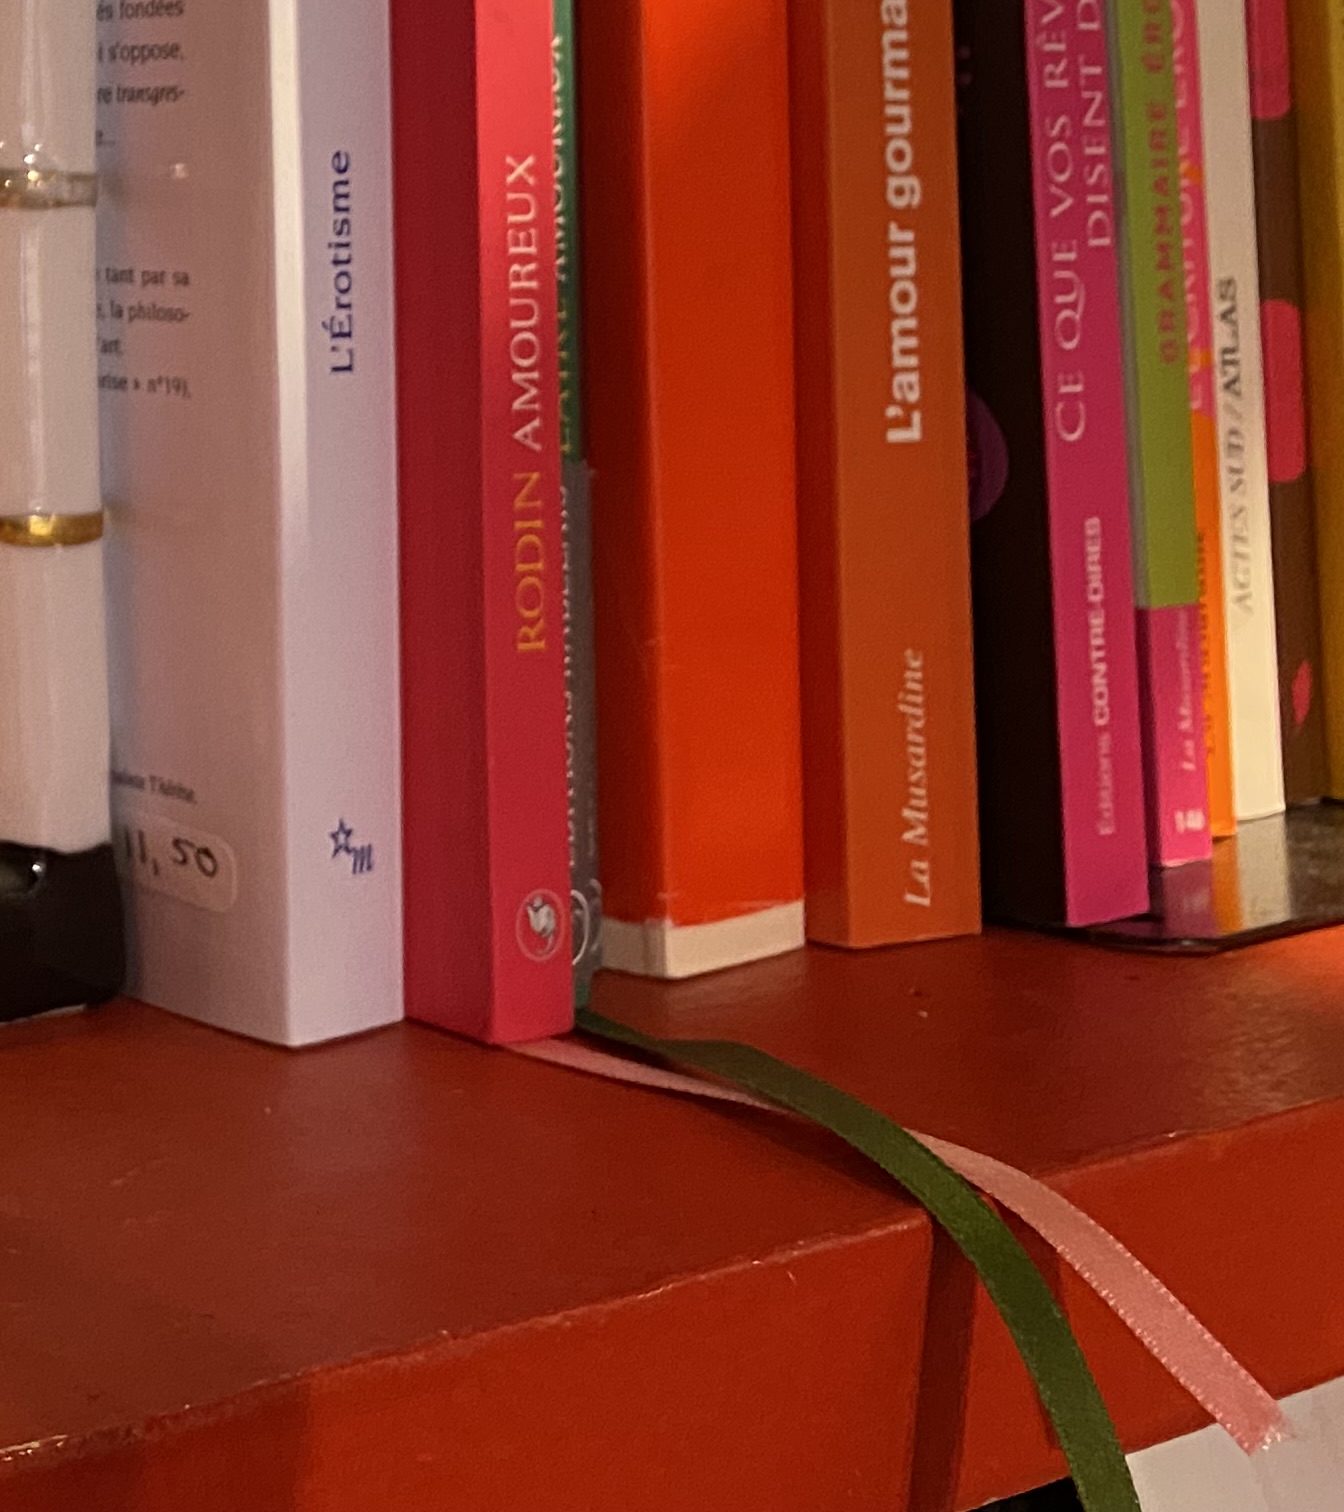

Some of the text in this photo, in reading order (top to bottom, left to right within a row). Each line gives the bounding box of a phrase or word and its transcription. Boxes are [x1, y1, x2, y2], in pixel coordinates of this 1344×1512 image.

[1045, 113, 1075, 218] VOS
[1077, 54, 1112, 248] DISENT
[1143, 96, 1178, 365] GRAMMAIRE
[322, 149, 355, 375] L'Érotisme
[886, 222, 923, 445] L'amour
[1050, 239, 1087, 351] QUE
[1216, 276, 1243, 398] ATLAS
[504, 153, 547, 654] RODIN AMOUREUX
[1054, 368, 1087, 443] CE
[897, 647, 932, 908] La Musardine
